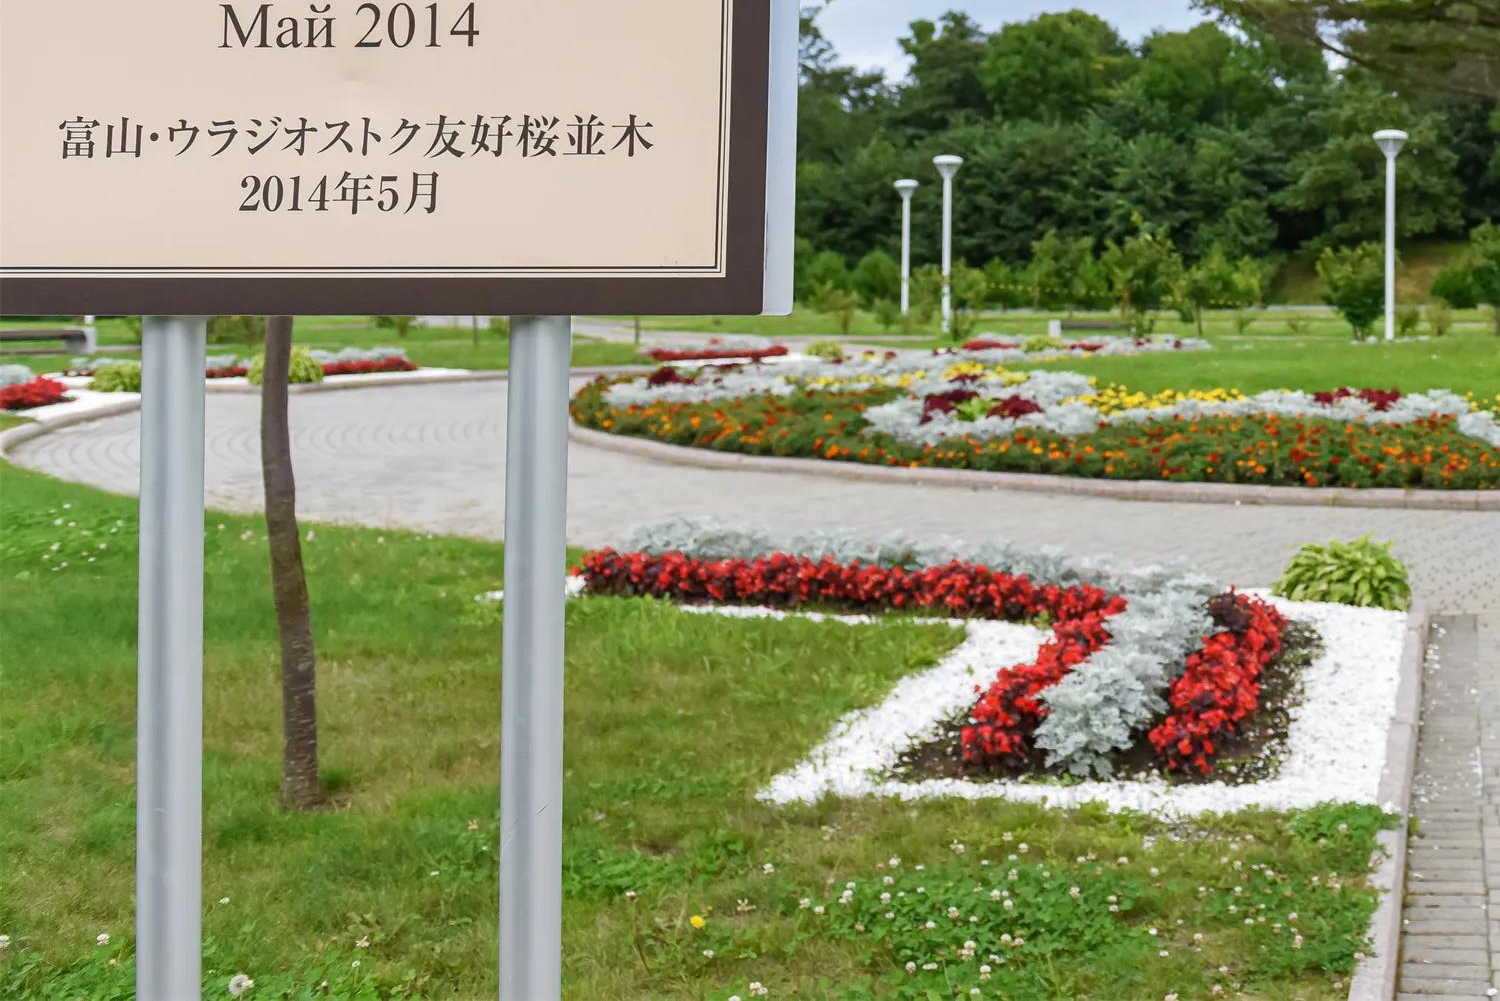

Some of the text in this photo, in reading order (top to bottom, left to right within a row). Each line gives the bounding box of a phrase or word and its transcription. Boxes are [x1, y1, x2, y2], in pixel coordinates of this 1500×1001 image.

[218, 2, 480, 49] Май 2014
[238, 170, 440, 215] 2014年5月
